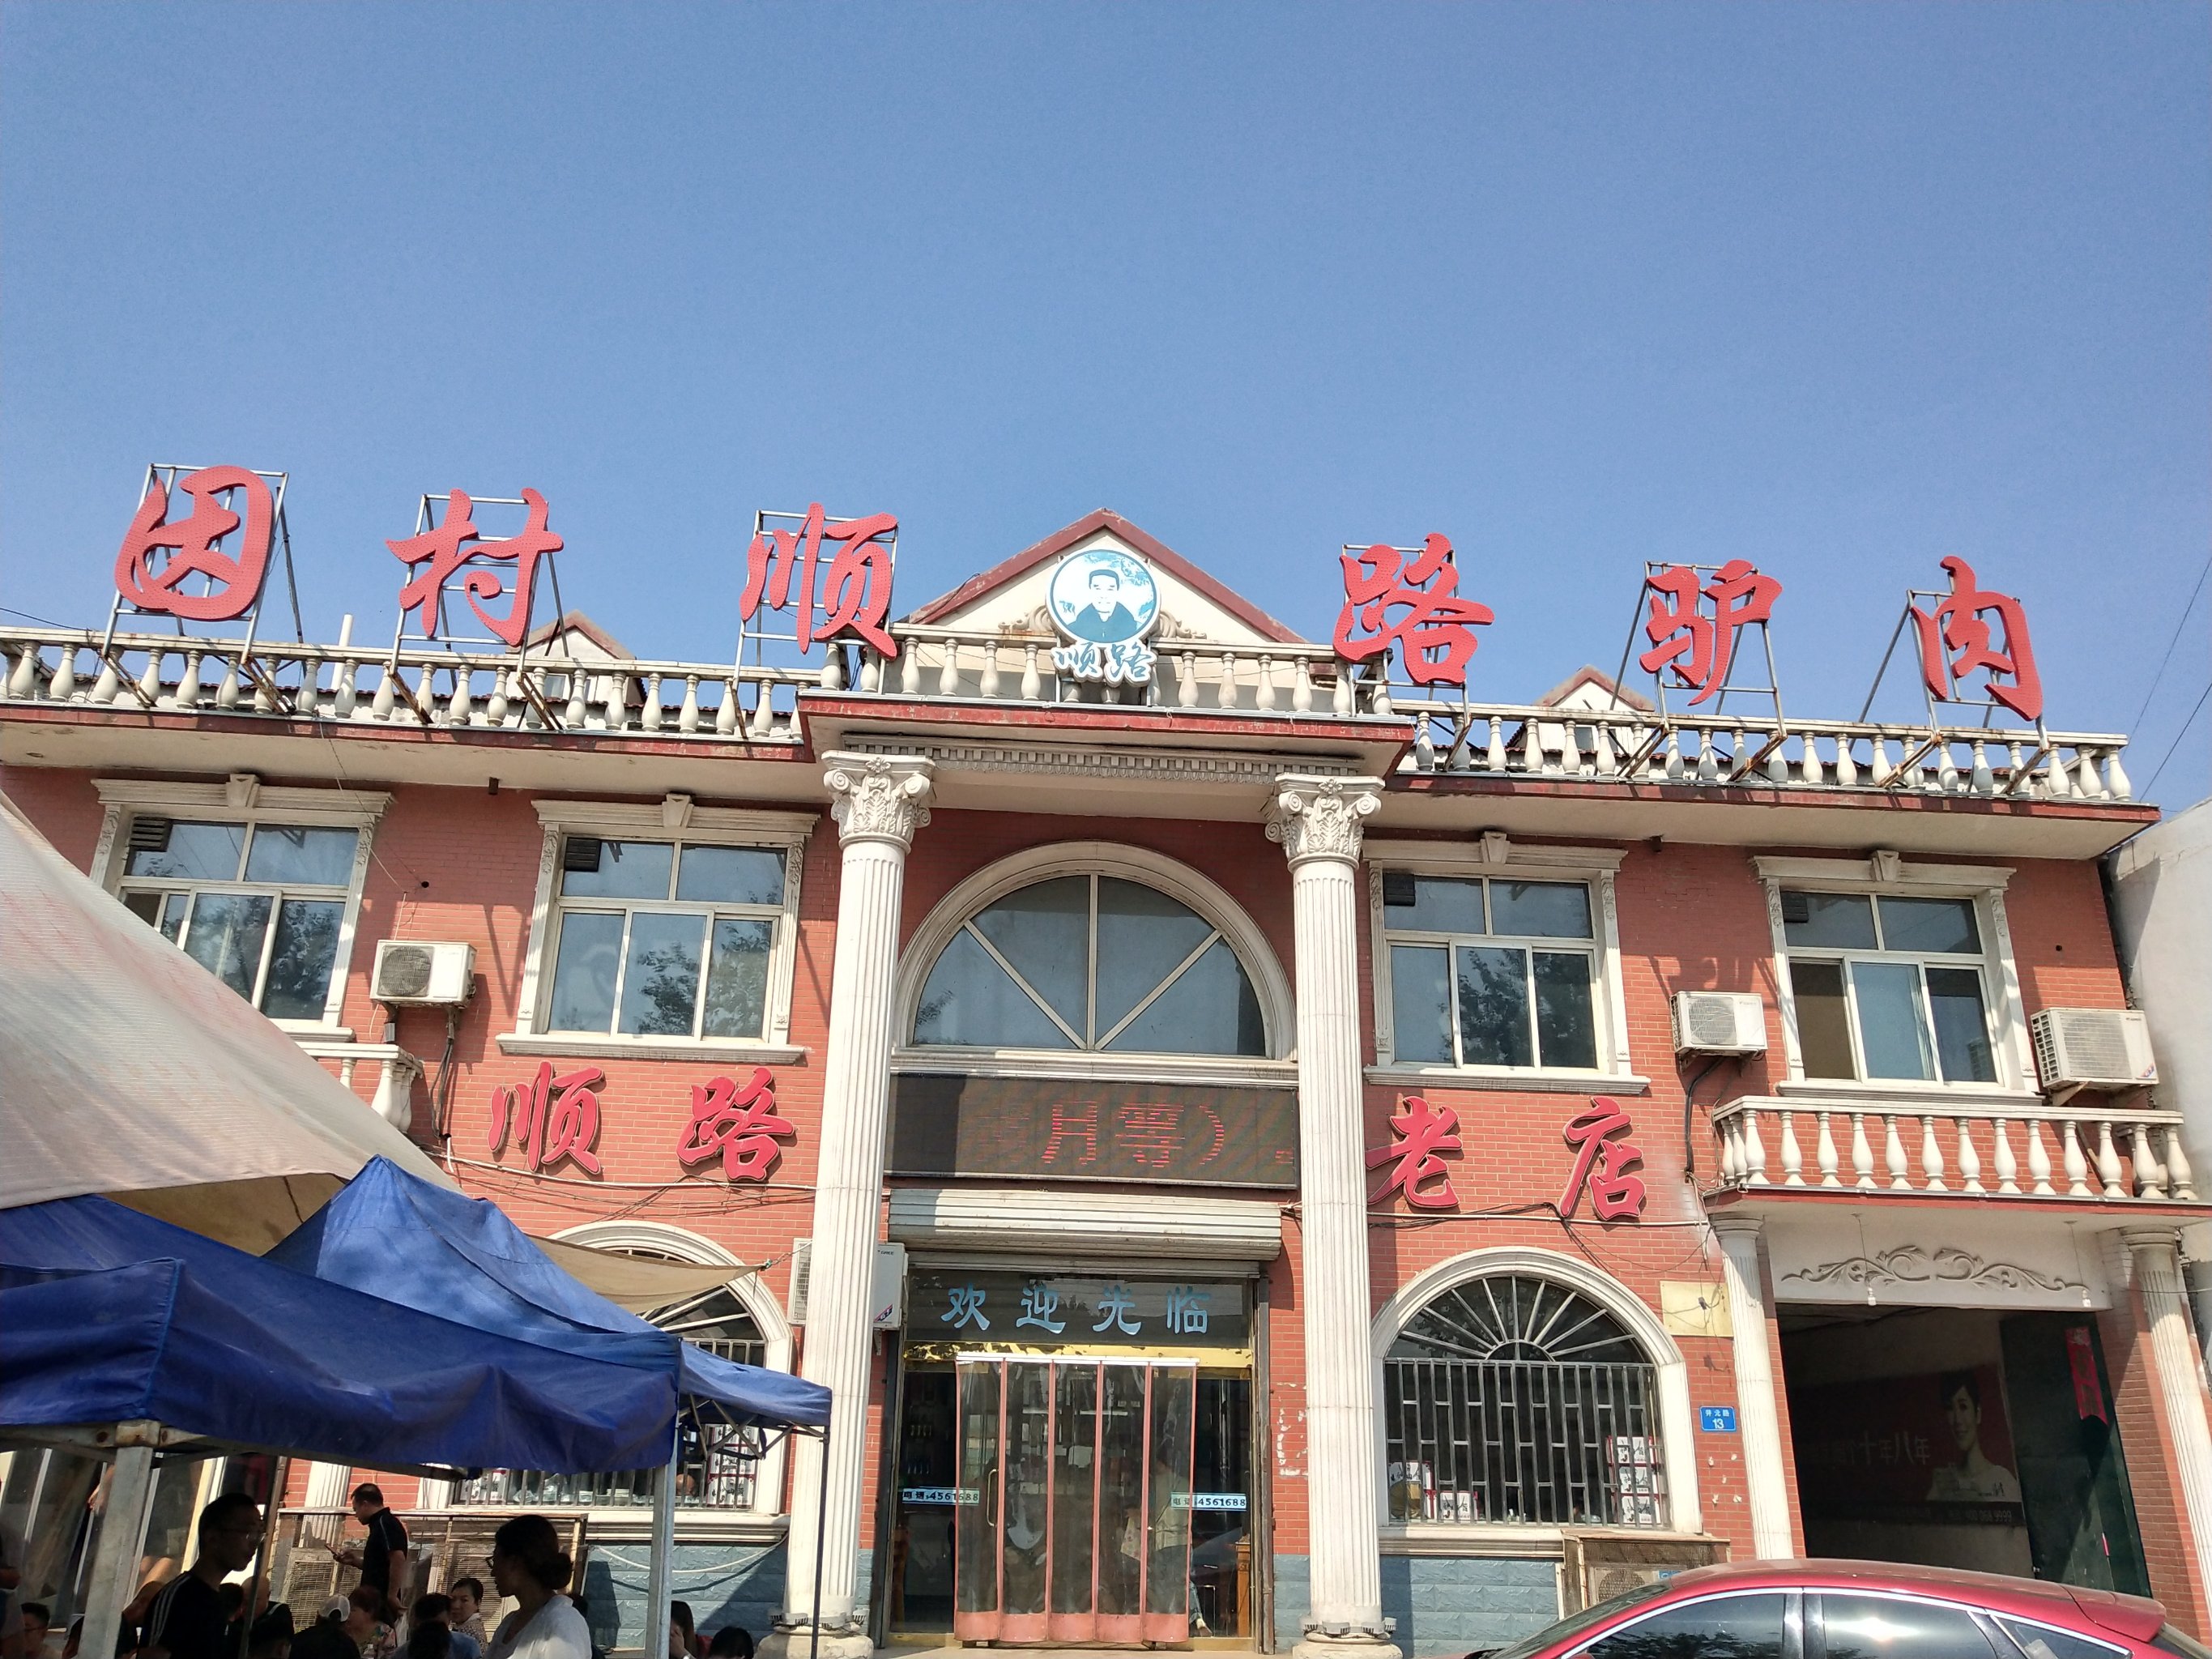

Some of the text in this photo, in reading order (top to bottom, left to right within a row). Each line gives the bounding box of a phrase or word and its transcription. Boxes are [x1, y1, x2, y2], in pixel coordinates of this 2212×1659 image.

[1055, 642, 1152, 679] 顺路
[940, 1282, 1211, 1335] 欢迎光临
[1711, 1418, 1724, 1429] 13
